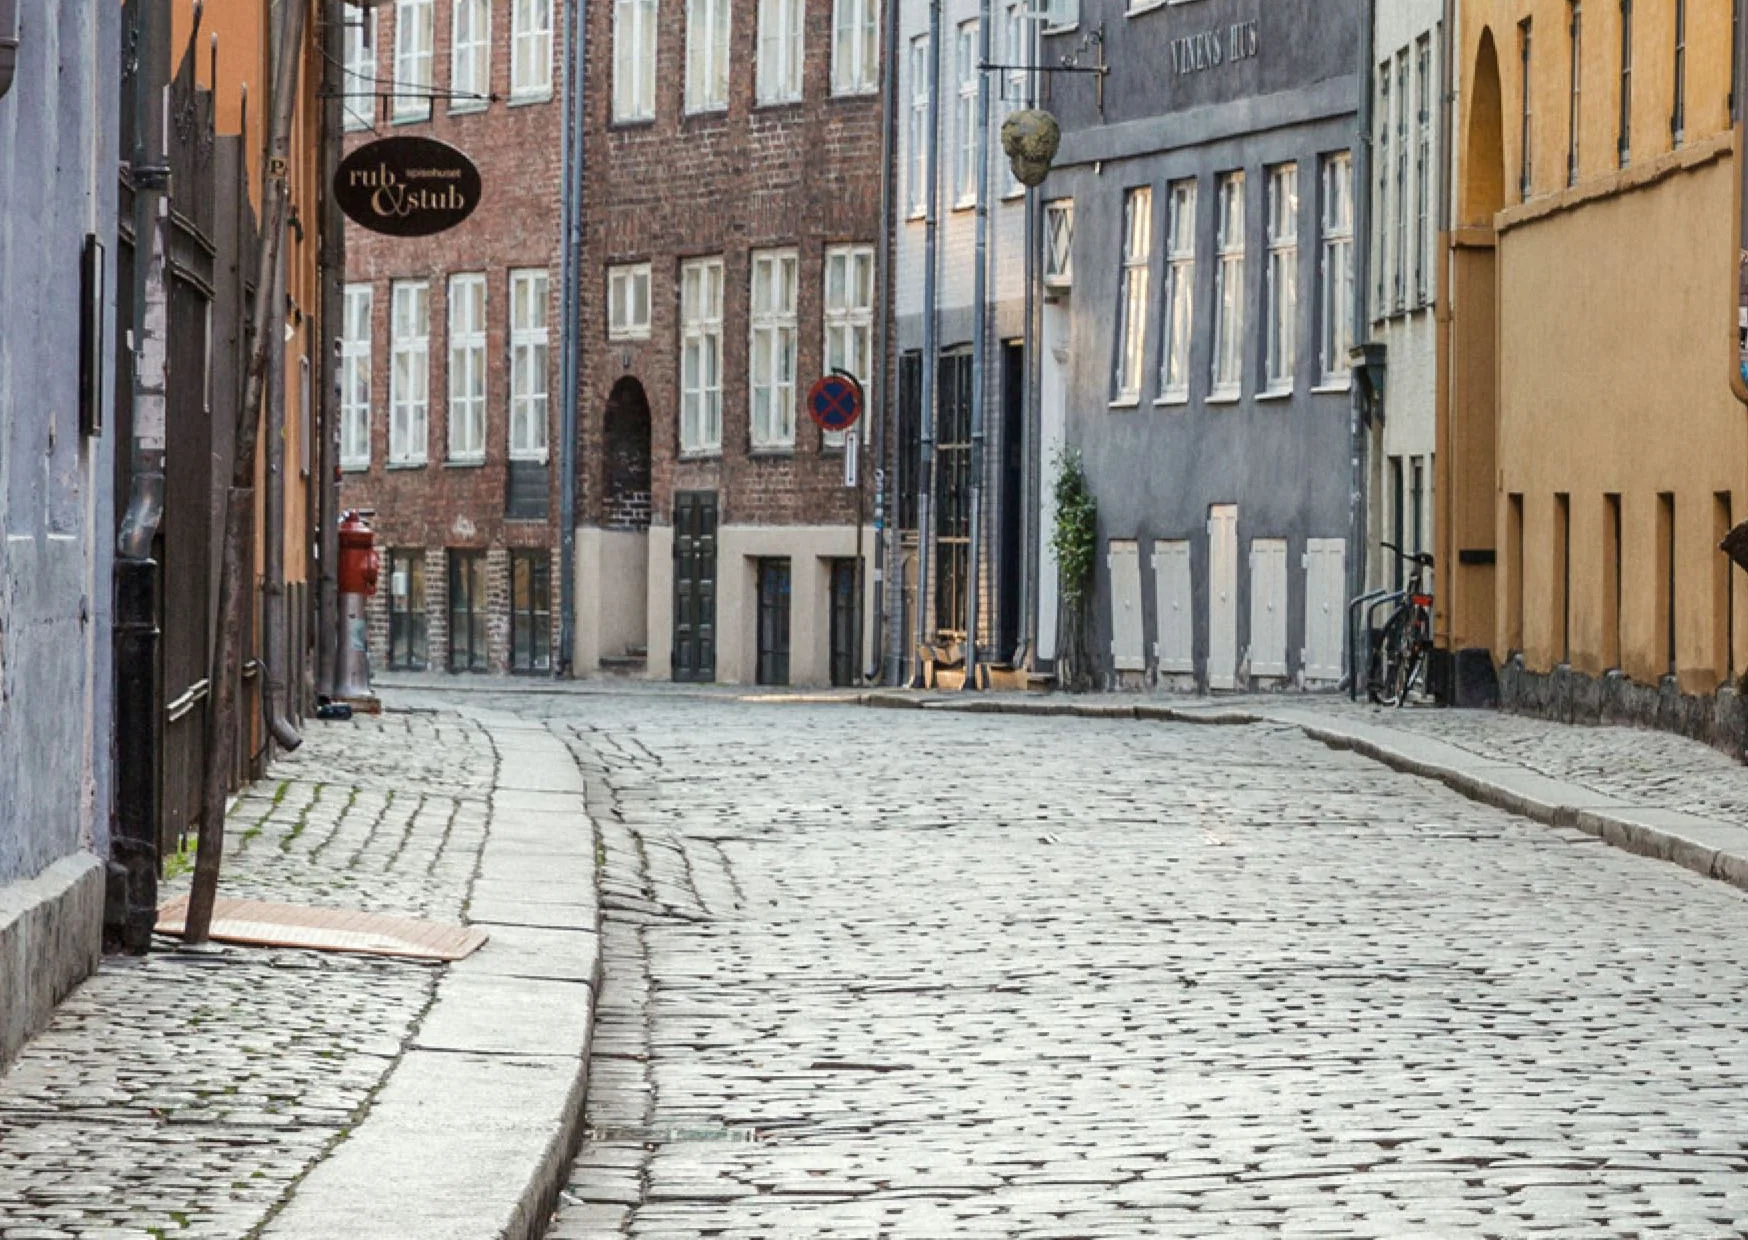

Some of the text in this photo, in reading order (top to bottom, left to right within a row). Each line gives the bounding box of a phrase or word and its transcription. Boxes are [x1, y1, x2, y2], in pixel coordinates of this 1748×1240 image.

[350, 162, 396, 187] rub
[371, 183, 465, 217] & stub
